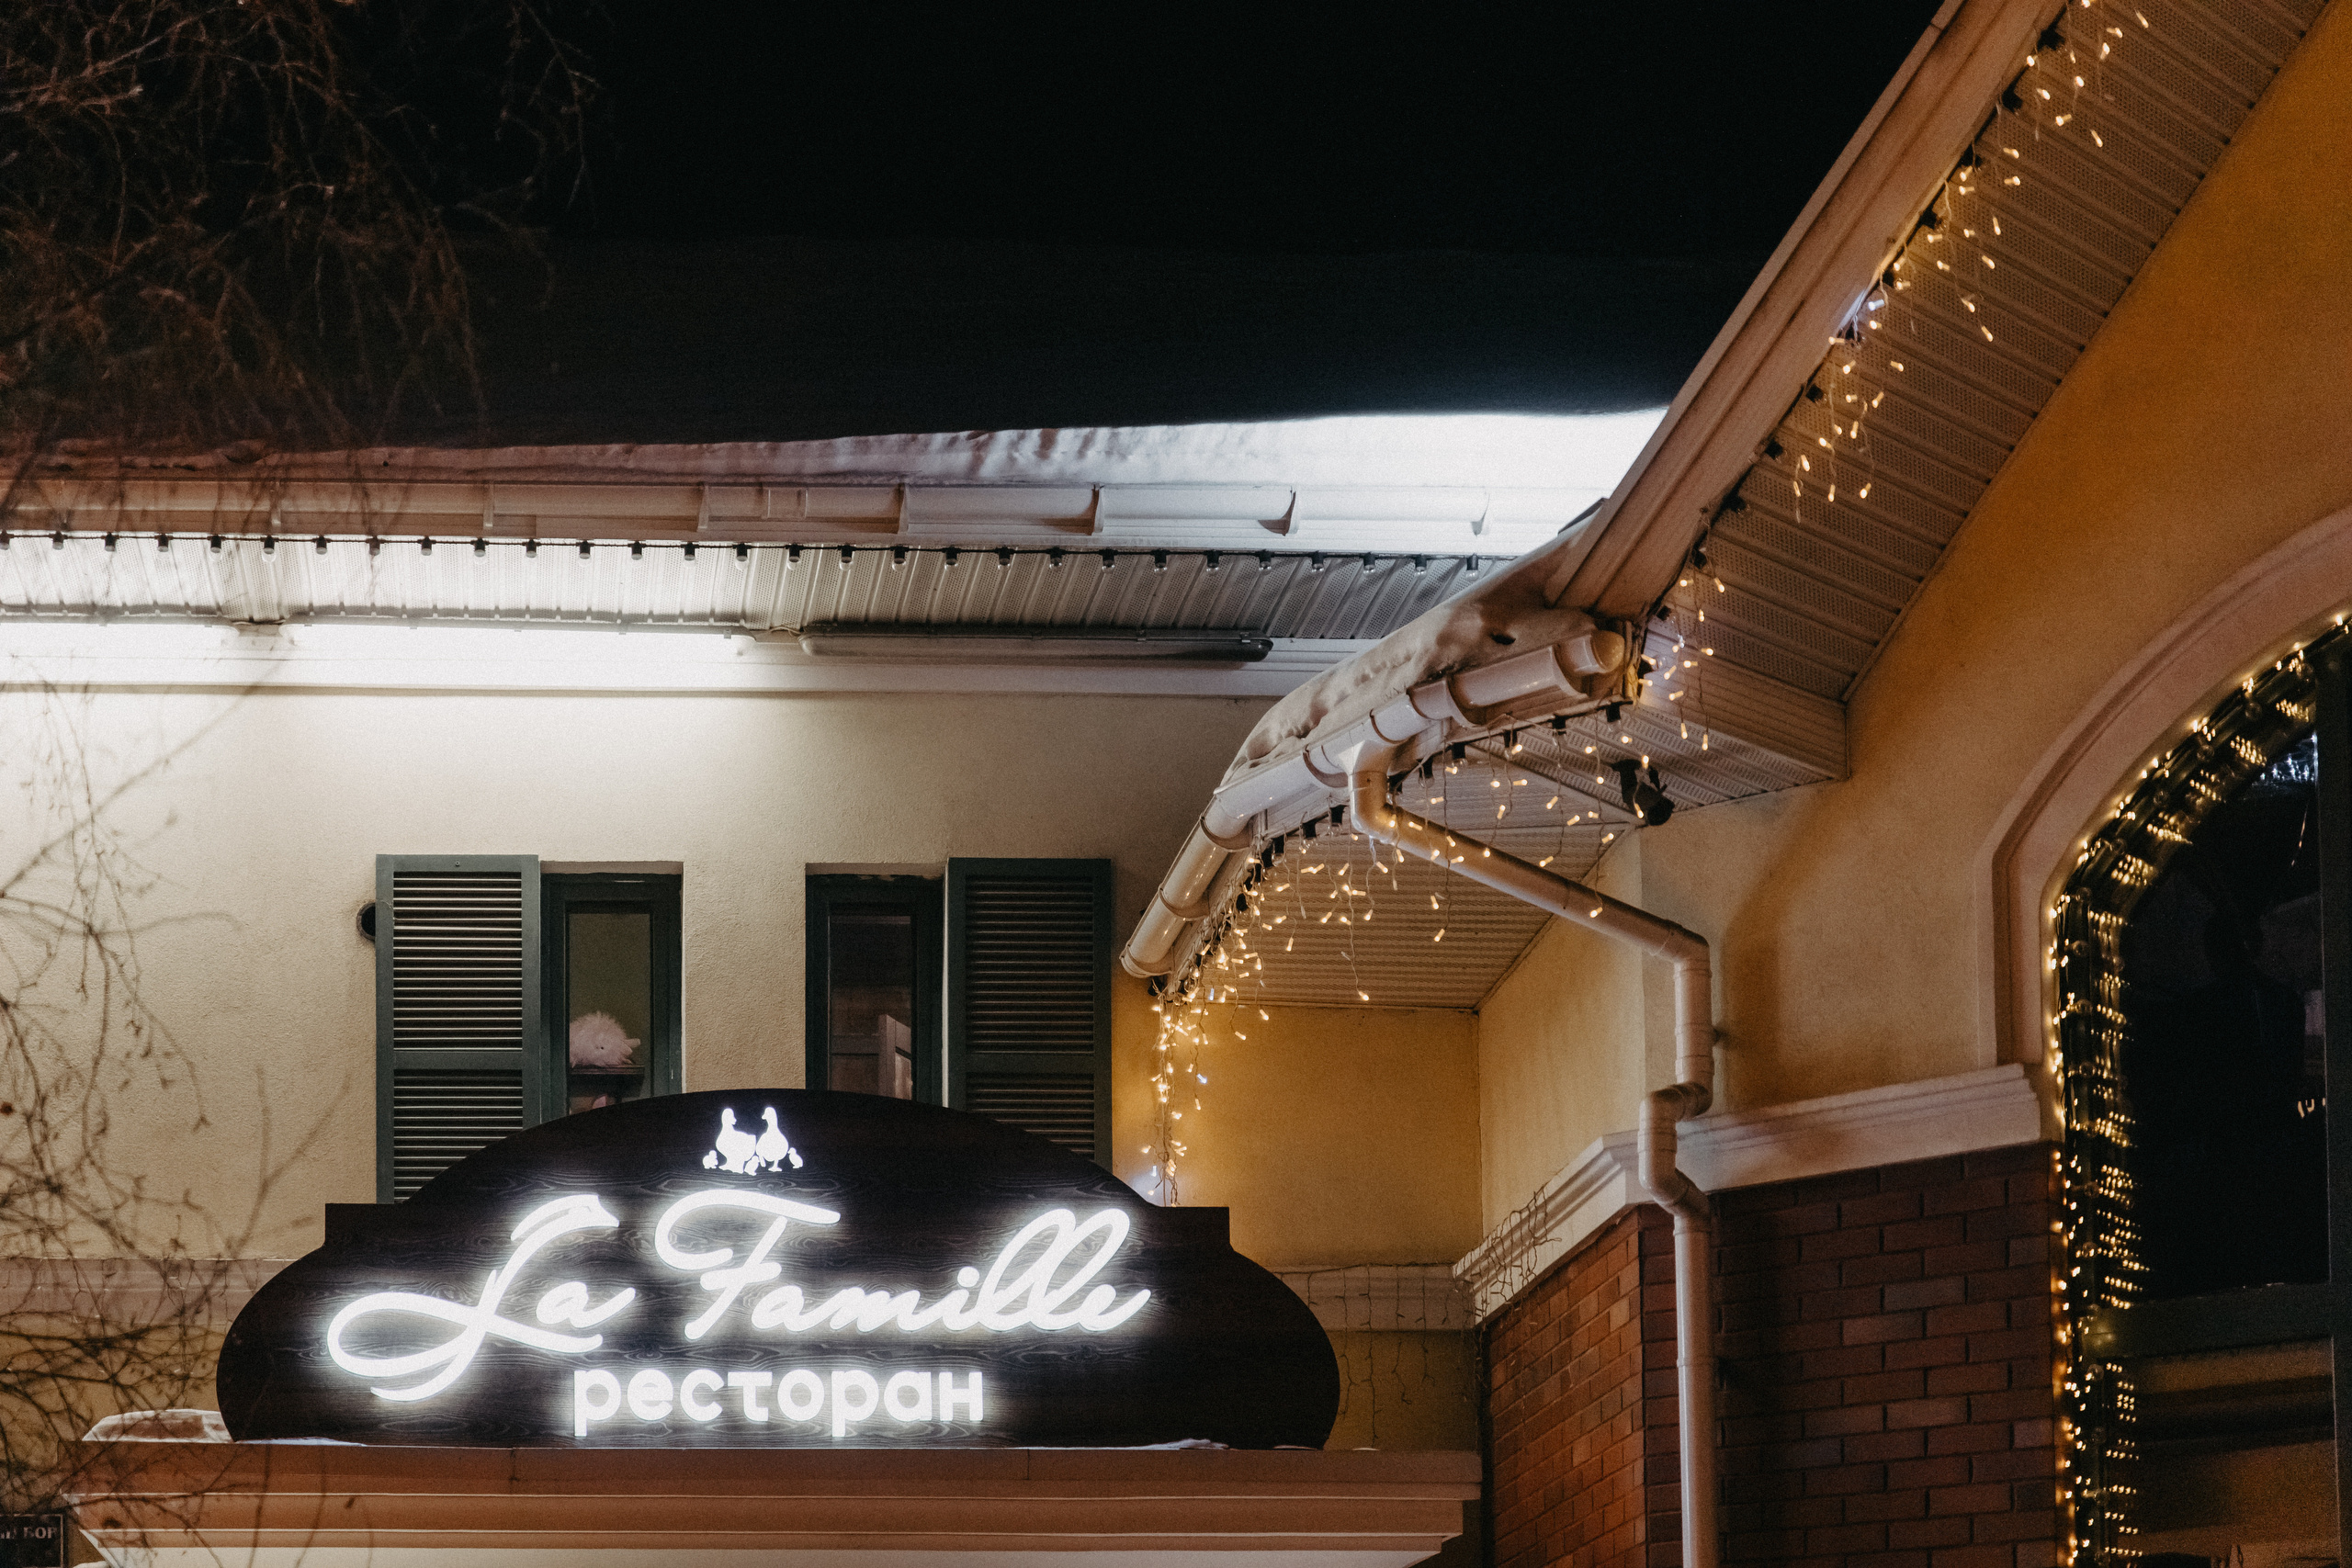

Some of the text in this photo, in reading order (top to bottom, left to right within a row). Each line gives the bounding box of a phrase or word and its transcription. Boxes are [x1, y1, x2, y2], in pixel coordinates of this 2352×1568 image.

[326, 1190, 1152, 1403] La Famille
[573, 1368, 984, 1438] ресторан
